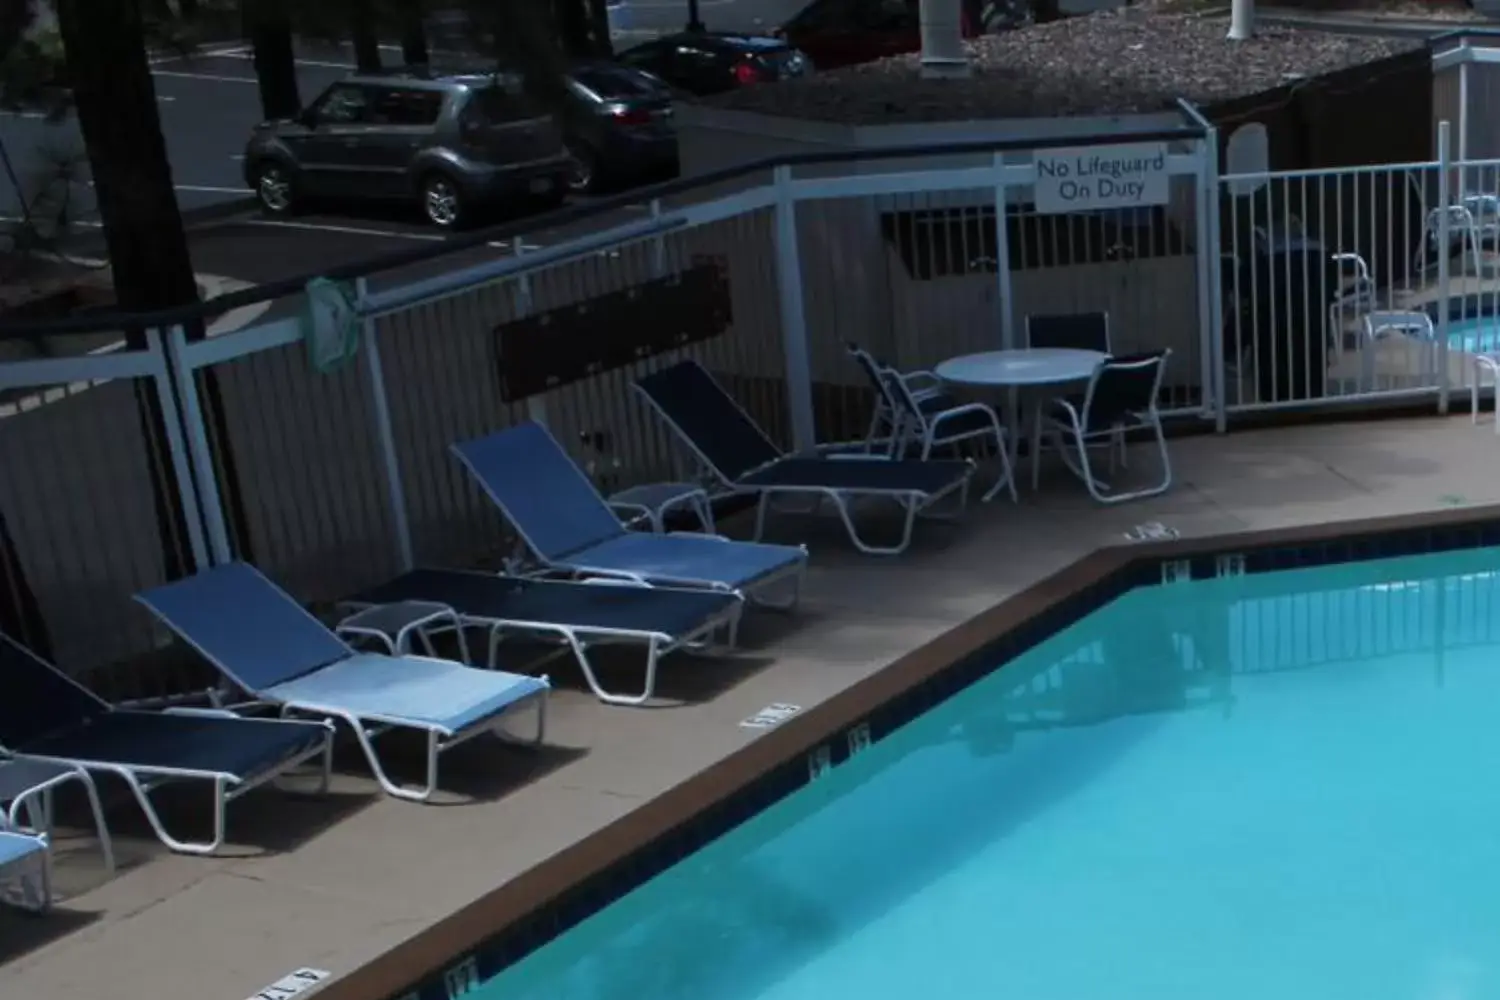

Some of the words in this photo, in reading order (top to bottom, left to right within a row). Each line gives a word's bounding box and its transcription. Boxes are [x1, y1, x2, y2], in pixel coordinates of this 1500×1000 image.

[1037, 159, 1069, 177] No
[1077, 146, 1164, 178] Lifeguard
[1059, 180, 1090, 201] On
[1098, 178, 1145, 200] Duty
